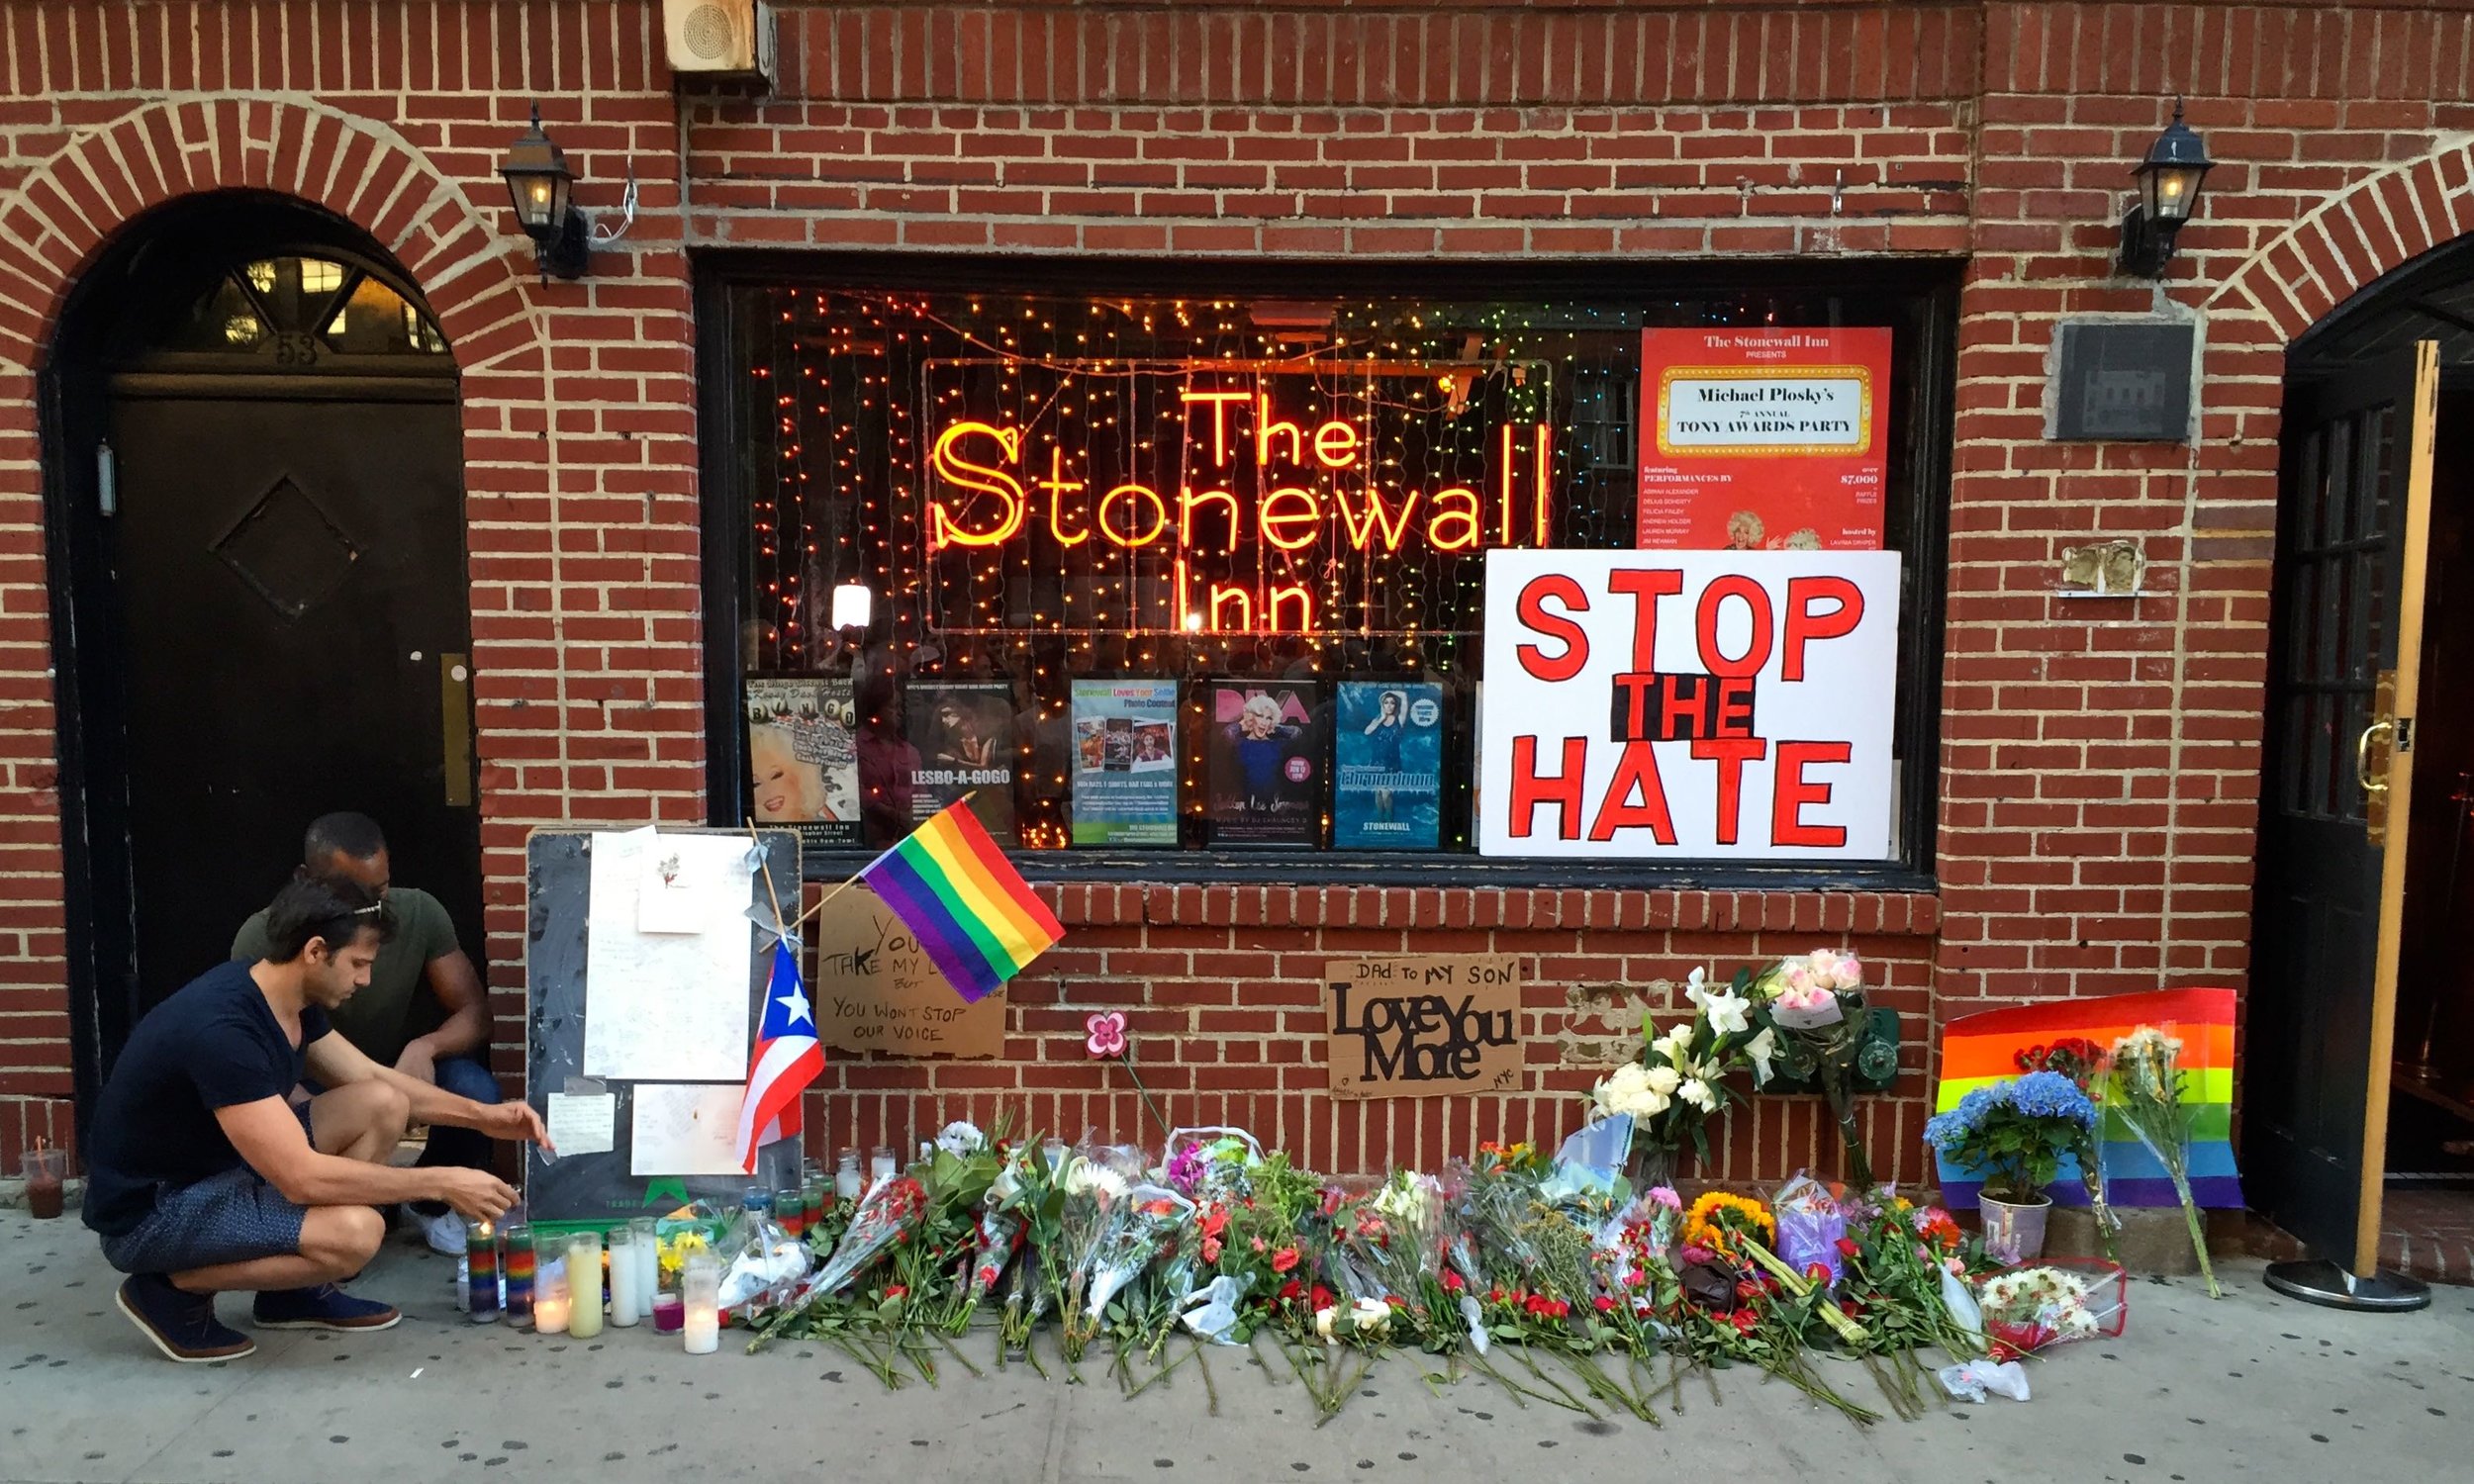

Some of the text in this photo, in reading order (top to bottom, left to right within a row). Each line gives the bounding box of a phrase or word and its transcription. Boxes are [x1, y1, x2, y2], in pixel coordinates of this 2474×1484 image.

[277, 335, 317, 364] 53
[1703, 334, 1829, 348] The Stonewall Inn
[1698, 387, 1835, 406] Michael Plosky's
[1180, 392, 1357, 468] The
[1676, 420, 1852, 433] TONY AWARDS PARTY
[932, 420, 1547, 550] Stonewall
[1644, 474, 1719, 483] PERFORMANCES
[1867, 527, 1876, 537] by
[1176, 560, 1311, 634] Inn
[1515, 568, 1865, 683] STOP
[1075, 688, 1112, 697] Stonewall
[1113, 688, 1136, 696] Loves
[1123, 698, 1147, 708] Photo
[1614, 673, 1755, 741] THE
[911, 769, 1010, 785] LESBO-A-GOGO
[1508, 736, 1853, 848] HATE
[1363, 822, 1410, 831] STONEWALL
[872, 915, 919, 956] YOU
[822, 946, 882, 977] TAKE
[893, 957, 919, 975] MY
[894, 977, 923, 990] BUT
[1425, 965, 1454, 985] MY
[1468, 962, 1515, 985] SON
[833, 996, 867, 1018] YOU
[922, 1006, 967, 1022] STOP
[1329, 981, 1518, 1048] Love You
[853, 1025, 944, 1042] OUR VOICE
[1359, 1028, 1481, 1082] More
[1492, 1068, 1514, 1088] NYC
